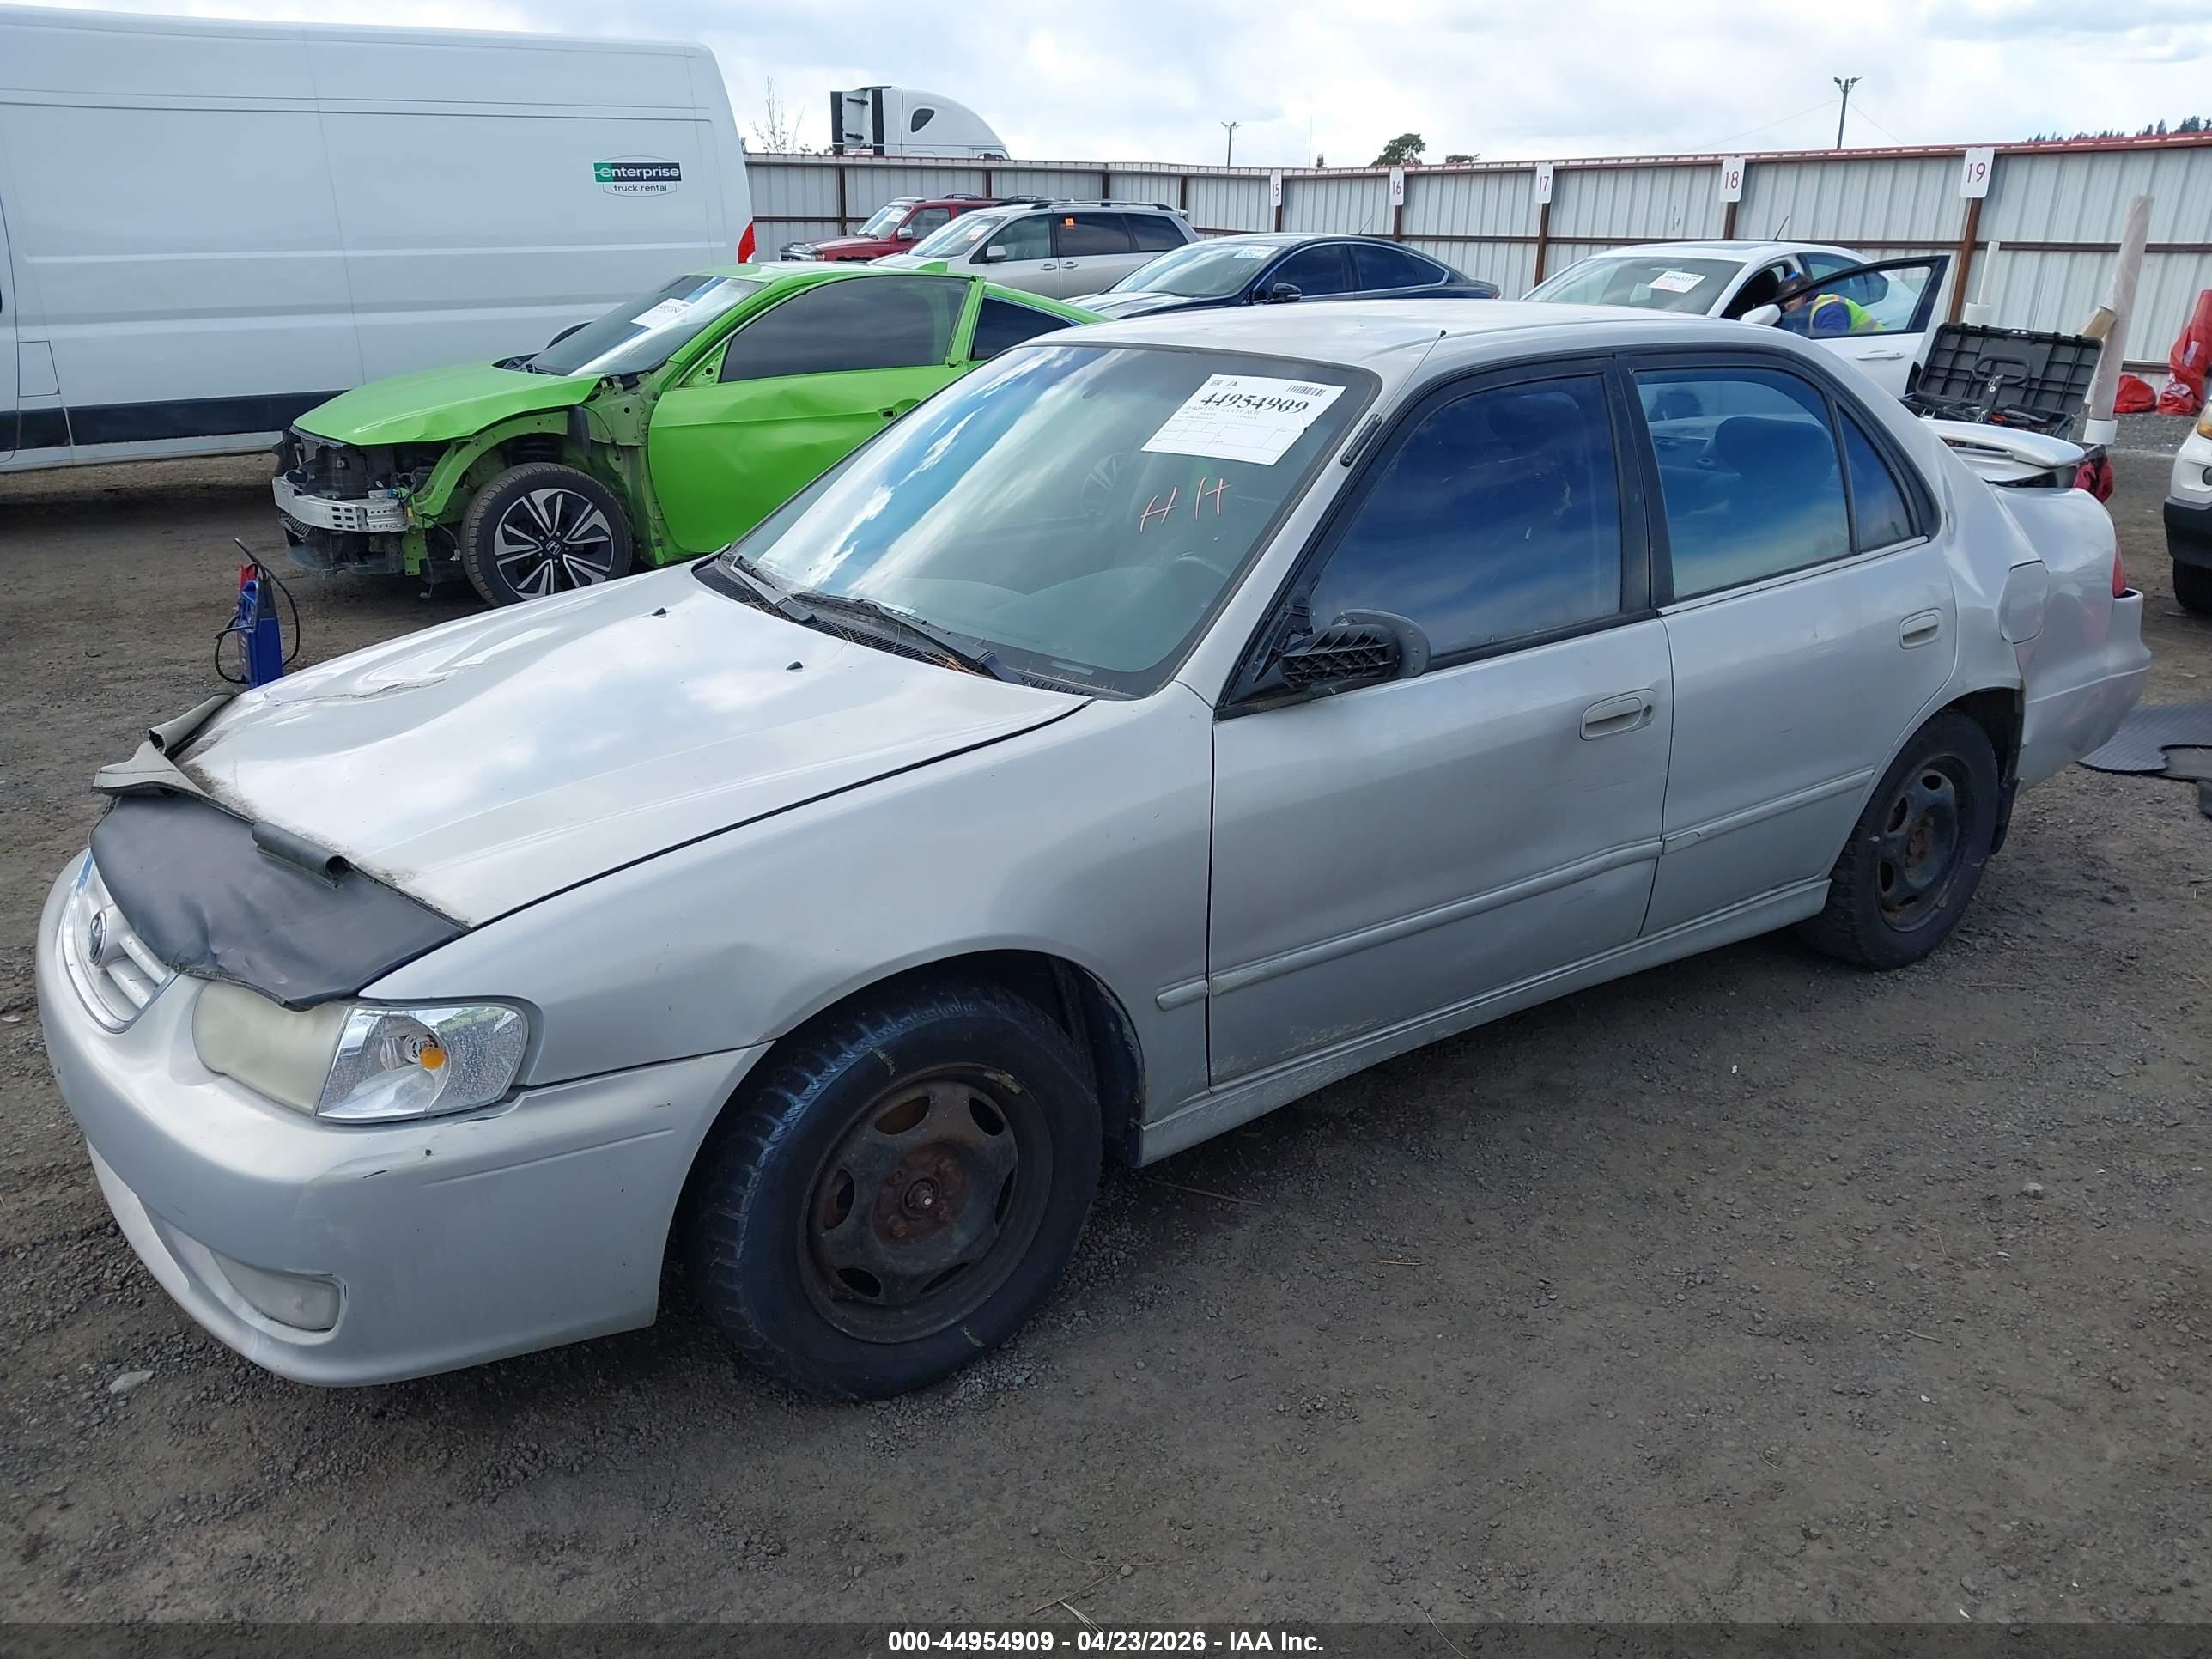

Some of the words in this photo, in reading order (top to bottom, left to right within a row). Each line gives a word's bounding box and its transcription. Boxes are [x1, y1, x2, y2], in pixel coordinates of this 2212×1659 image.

[594, 166, 679, 179] enterprise
[1724, 171, 1740, 189] 18
[1966, 162, 1986, 183] 19
[1272, 184, 1280, 197] 15
[1392, 180, 1401, 195] 16
[1539, 176, 1549, 191] 17
[1200, 392, 1309, 414] 44954909
